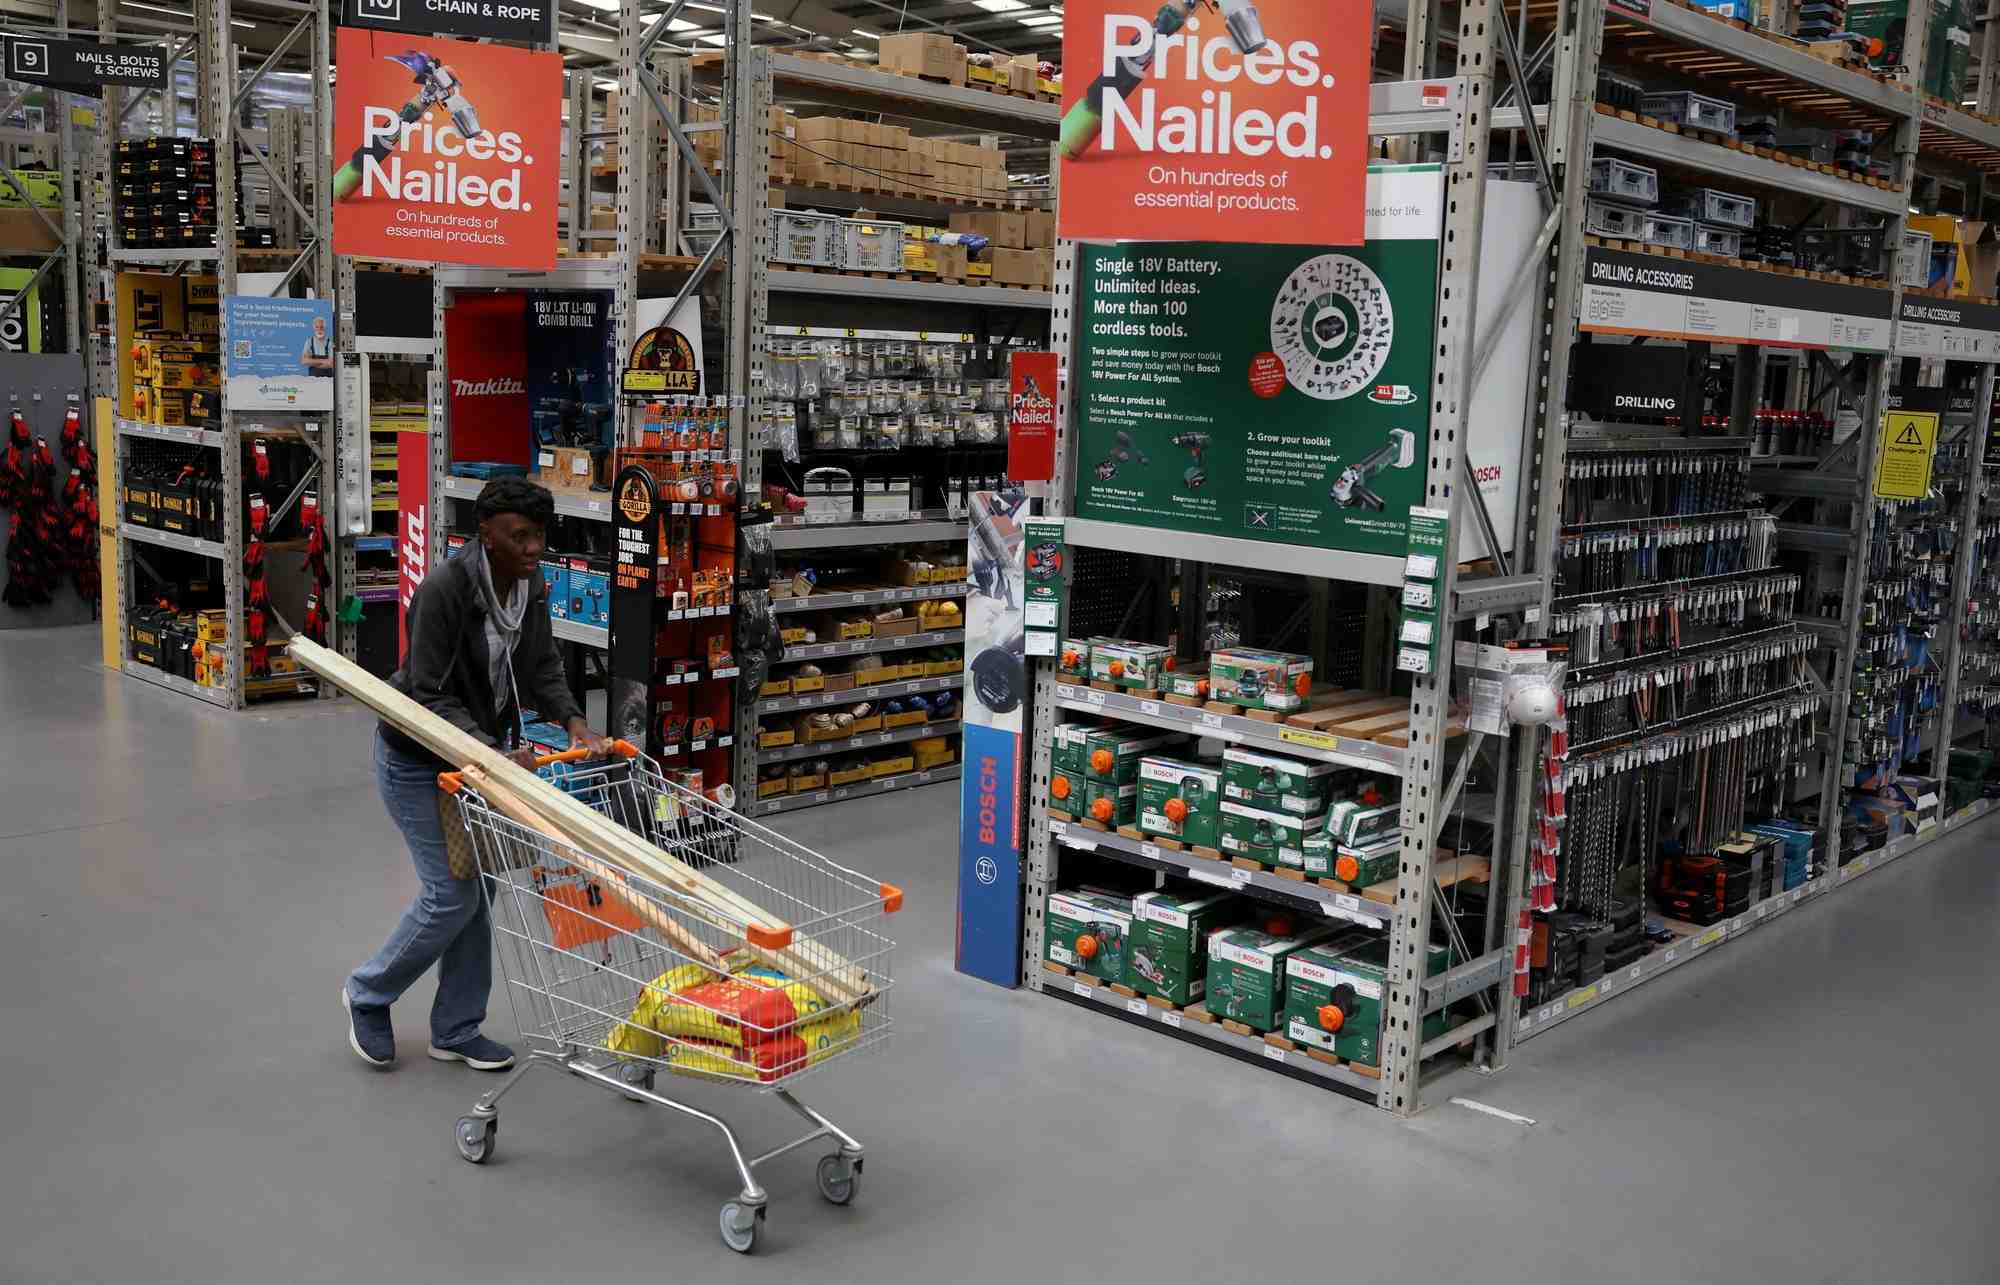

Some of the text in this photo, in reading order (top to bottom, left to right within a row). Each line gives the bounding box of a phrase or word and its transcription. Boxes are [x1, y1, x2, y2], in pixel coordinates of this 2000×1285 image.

[426, 0, 540, 21] CHAIN & ROPE
[1103, 14, 1335, 88] Prices.
[24, 52, 38, 66] 9
[75, 52, 160, 67] NAILS, BOLTS
[95, 65, 160, 78] & SCREWS
[1101, 86, 1334, 159] Nailed.
[363, 106, 534, 165] Prices.
[362, 154, 532, 212] Nailed.
[1148, 167, 1288, 188] On hundreds of
[1134, 191, 1300, 213] essential products.
[396, 209, 498, 229] On hundreds of
[386, 225, 443, 240] essential
[1095, 258, 1222, 275] Single 18V Battery.
[1592, 262, 1694, 290] DRILLING ACCESSORIES
[1094, 279, 1201, 294] Unlimited Ideas.
[534, 302, 551, 313] 18V
[553, 302, 570, 313] LXT
[1094, 300, 1188, 315] More than 100
[1903, 304, 1961, 322] DRILLING ACCESSORIES
[538, 314, 593, 327] COMBI DRILL
[799, 326, 808, 335] A
[919, 330, 928, 340] C
[1092, 321, 1188, 337] cordless tools.
[1092, 347, 1105, 356] Two
[1106, 348, 1129, 358] simple
[1131, 350, 1150, 359] steps
[1197, 365, 1221, 373] Bosch
[1105, 371, 1126, 380] Power
[1128, 372, 1139, 381] For
[1141, 373, 1152, 382] All
[1154, 374, 1182, 384] System.
[1013, 394, 1054, 408] Prices.
[1098, 394, 1119, 403] Select
[1126, 395, 1155, 405] product
[1615, 395, 1676, 410] DRILLING
[1013, 409, 1053, 424] Nailed.
[1247, 432, 1331, 446] 2. Grow your toolkit
[621, 500, 649, 514] GORILLA
[618, 528, 643, 541] FOR THE
[618, 539, 650, 555] TOUGHEST
[618, 552, 634, 564] JOBS
[628, 566, 650, 579] PLANET
[617, 575, 638, 589] EARTH
[1153, 769, 1173, 778] BOSCH
[979, 757, 998, 845] BOSCH
[1242, 953, 1264, 966] BOSCH
[1302, 967, 1326, 979] BOSCH
[1292, 1027, 1305, 1036] 18V
